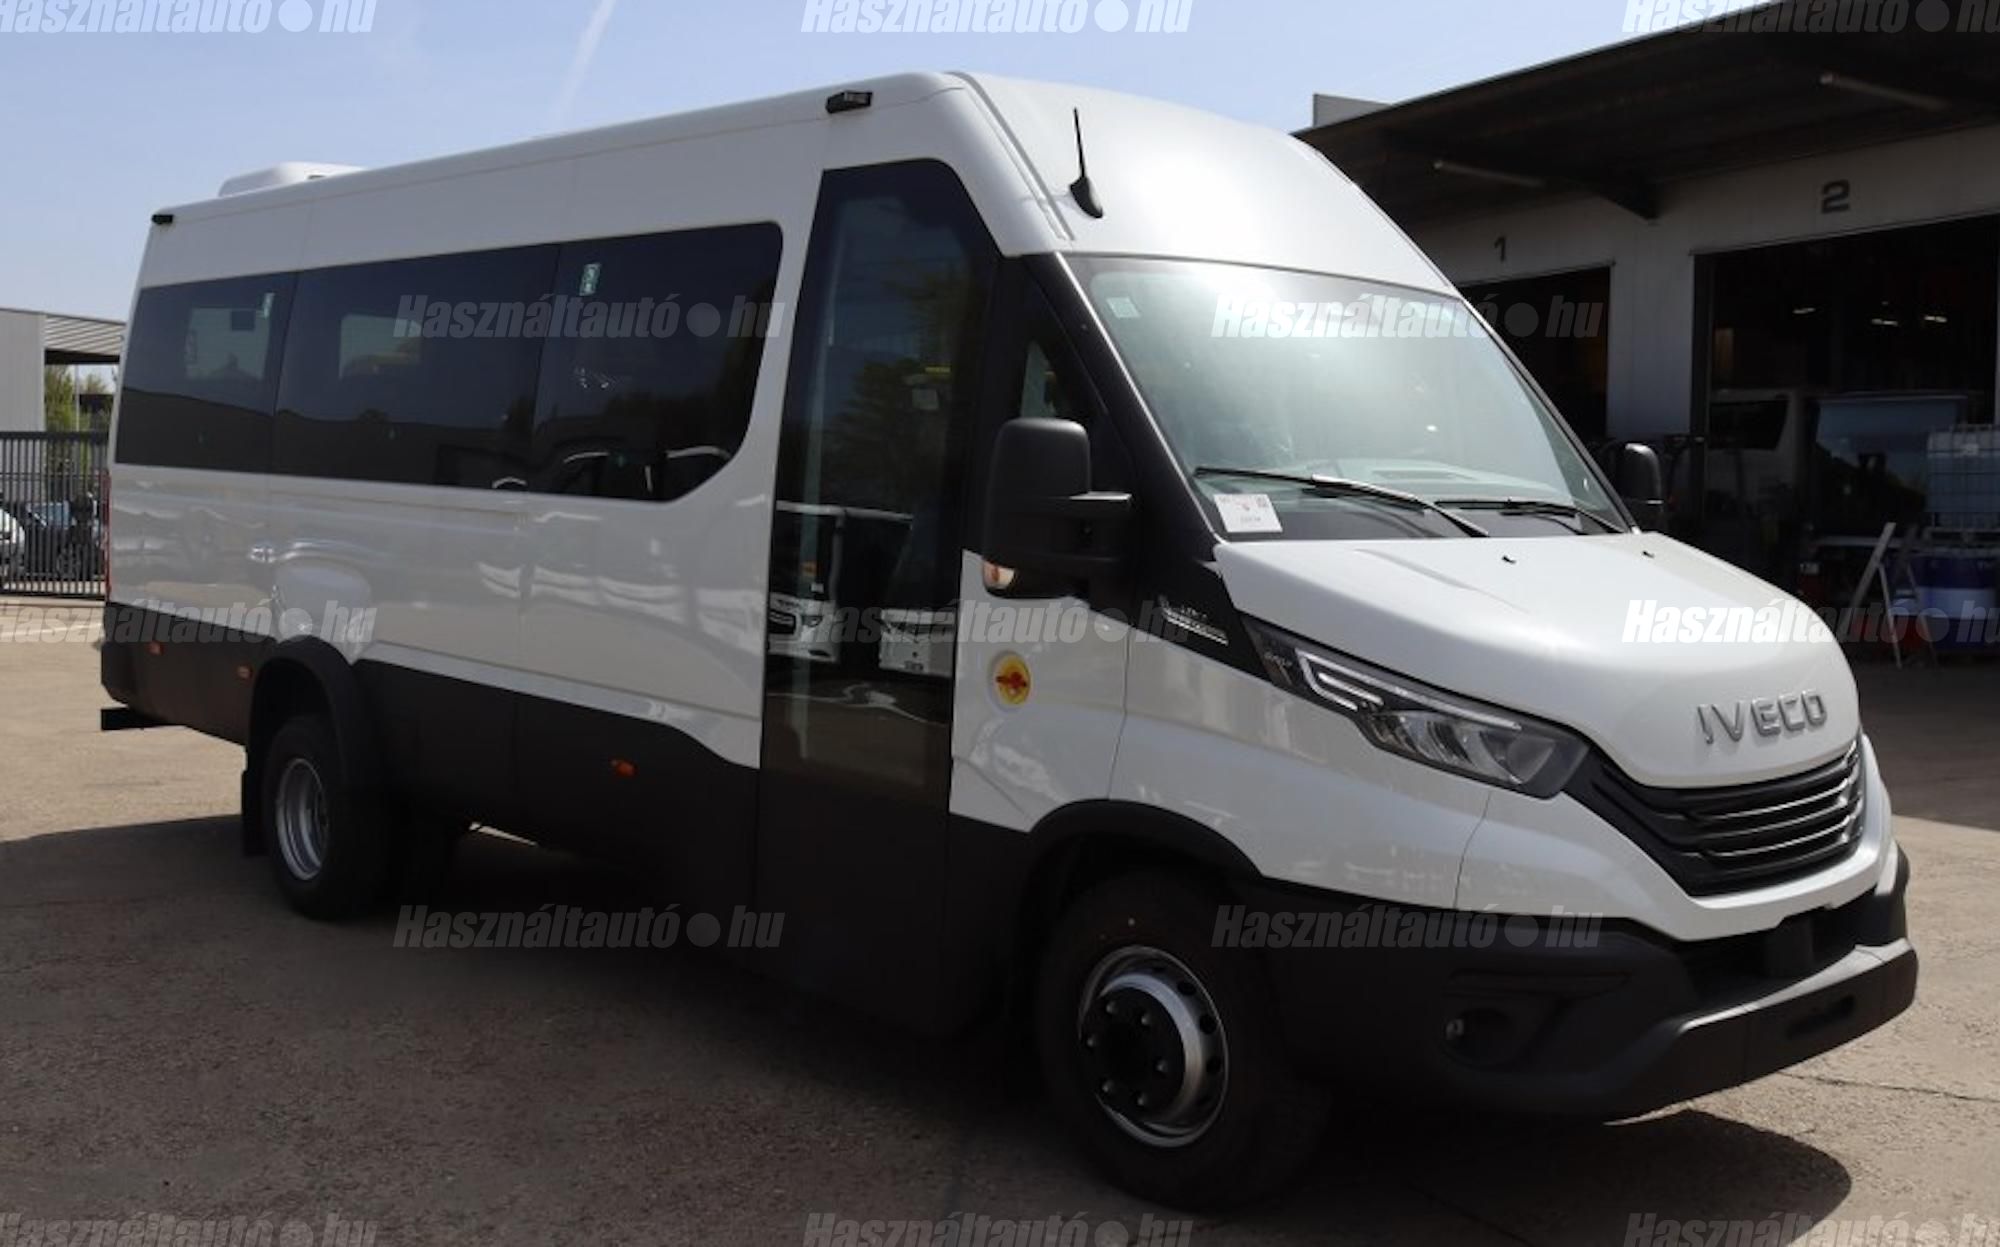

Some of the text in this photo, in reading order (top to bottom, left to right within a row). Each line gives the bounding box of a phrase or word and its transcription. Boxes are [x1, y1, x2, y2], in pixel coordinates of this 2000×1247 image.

[1819, 179, 1852, 214] 2
[1493, 235, 1507, 262] 1
[1697, 689, 1828, 745] IVECO
